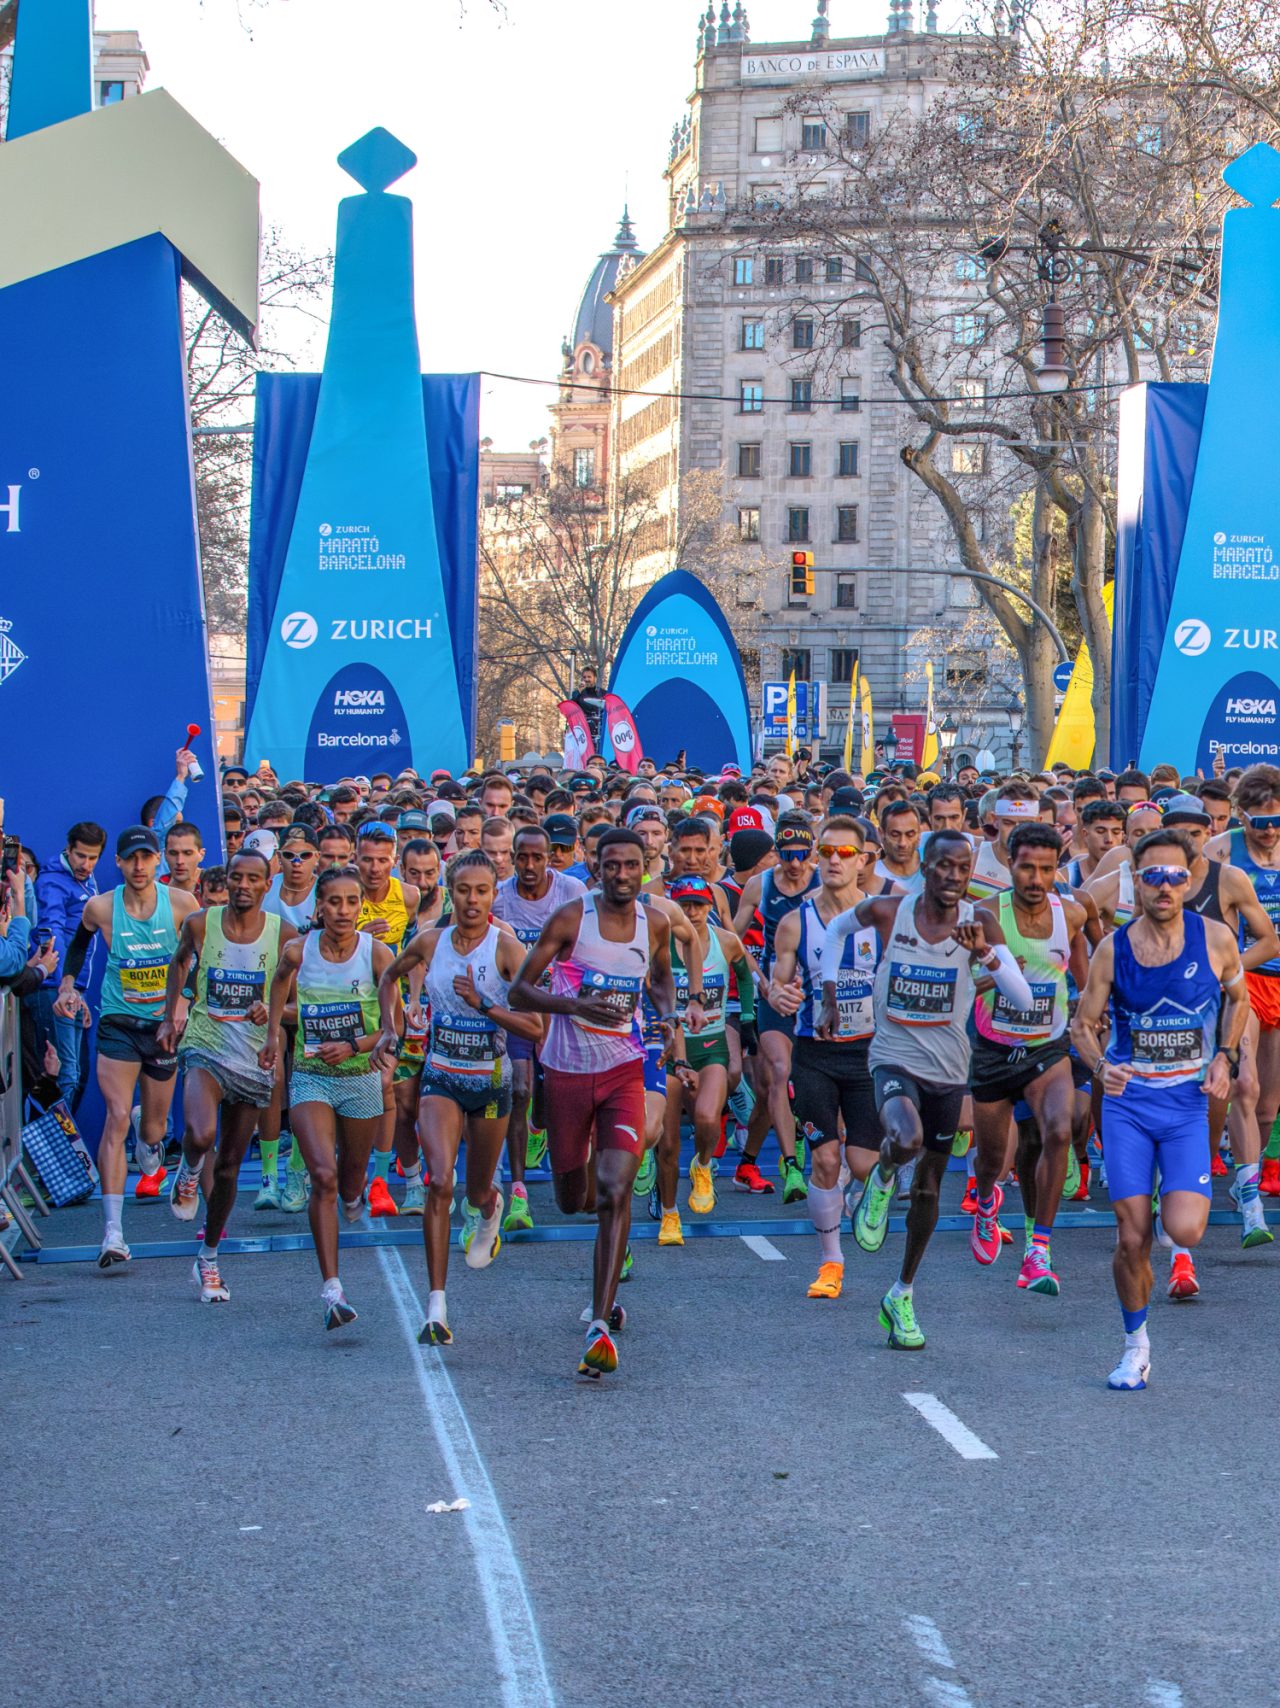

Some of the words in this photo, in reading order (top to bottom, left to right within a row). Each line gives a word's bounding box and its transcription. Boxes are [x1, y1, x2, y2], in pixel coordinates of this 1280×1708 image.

[747, 58, 801, 74] BANCO
[807, 60, 821, 71] DE
[827, 52, 879, 69] ESPAÑA
[335, 525, 370, 534] ZURICH
[319, 535, 379, 553] MARATÓ
[1230, 535, 1264, 543] ZURICH
[1213, 545, 1273, 563] MARATÓ
[319, 554, 406, 570] BARCELONA
[331, 619, 432, 640] ZURICH
[646, 636, 696, 651] MARATÓ
[646, 652, 718, 665] BARCELONA
[334, 690, 385, 705] HOKA
[766, 686, 788, 714] P
[1225, 698, 1277, 715] HOKA
[318, 732, 387, 747] Barcelona
[1209, 740, 1278, 755] Barcelona
[737, 815, 756, 827] USA
[138, 958, 163, 966] ZURICH
[129, 968, 165, 981] BOYAN
[227, 972, 255, 981] ZURICH
[915, 970, 946, 978] ZURICH
[608, 978, 635, 987] ZURICH
[895, 977, 949, 998] ÖZBILEN
[215, 983, 254, 996] PACER
[836, 989, 863, 997] ZURICH
[320, 1004, 350, 1013] ZURICH
[919, 998, 925, 1007] 6
[305, 1014, 360, 1030] ETAGEGN
[455, 1020, 486, 1028] ZURICH
[1156, 1017, 1190, 1026] ZURICH
[330, 1031, 341, 1039] 63
[438, 1028, 489, 1046] ZEINEBA
[1139, 1031, 1195, 1047] BORGES
[459, 1047, 470, 1056] 62
[1164, 1049, 1175, 1058] 20
